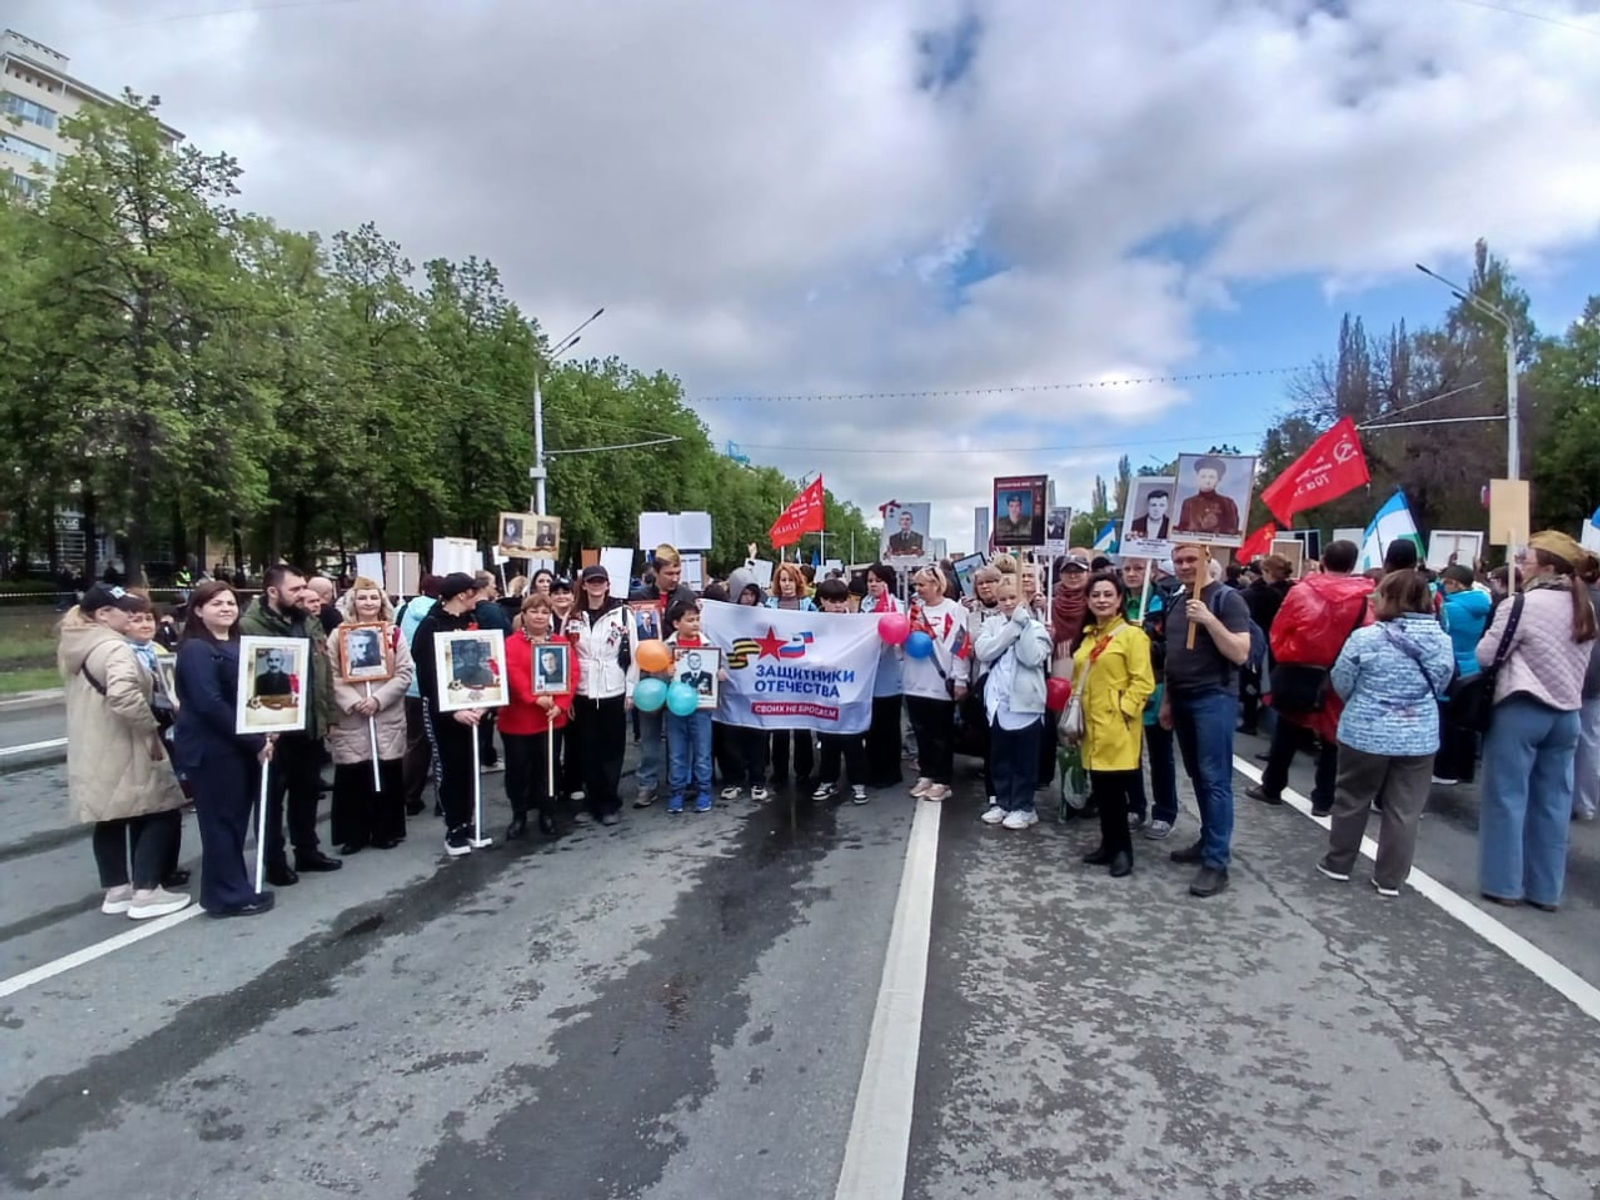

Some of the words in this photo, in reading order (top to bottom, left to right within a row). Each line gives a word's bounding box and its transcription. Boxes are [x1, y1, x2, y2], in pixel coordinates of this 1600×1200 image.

[756, 665, 855, 684] ЗАЩИТНИКИ
[754, 680, 840, 698] ОТЕЧЕСТВА
[754, 704, 783, 713] СВОИХ
[786, 705, 798, 713] НЕ
